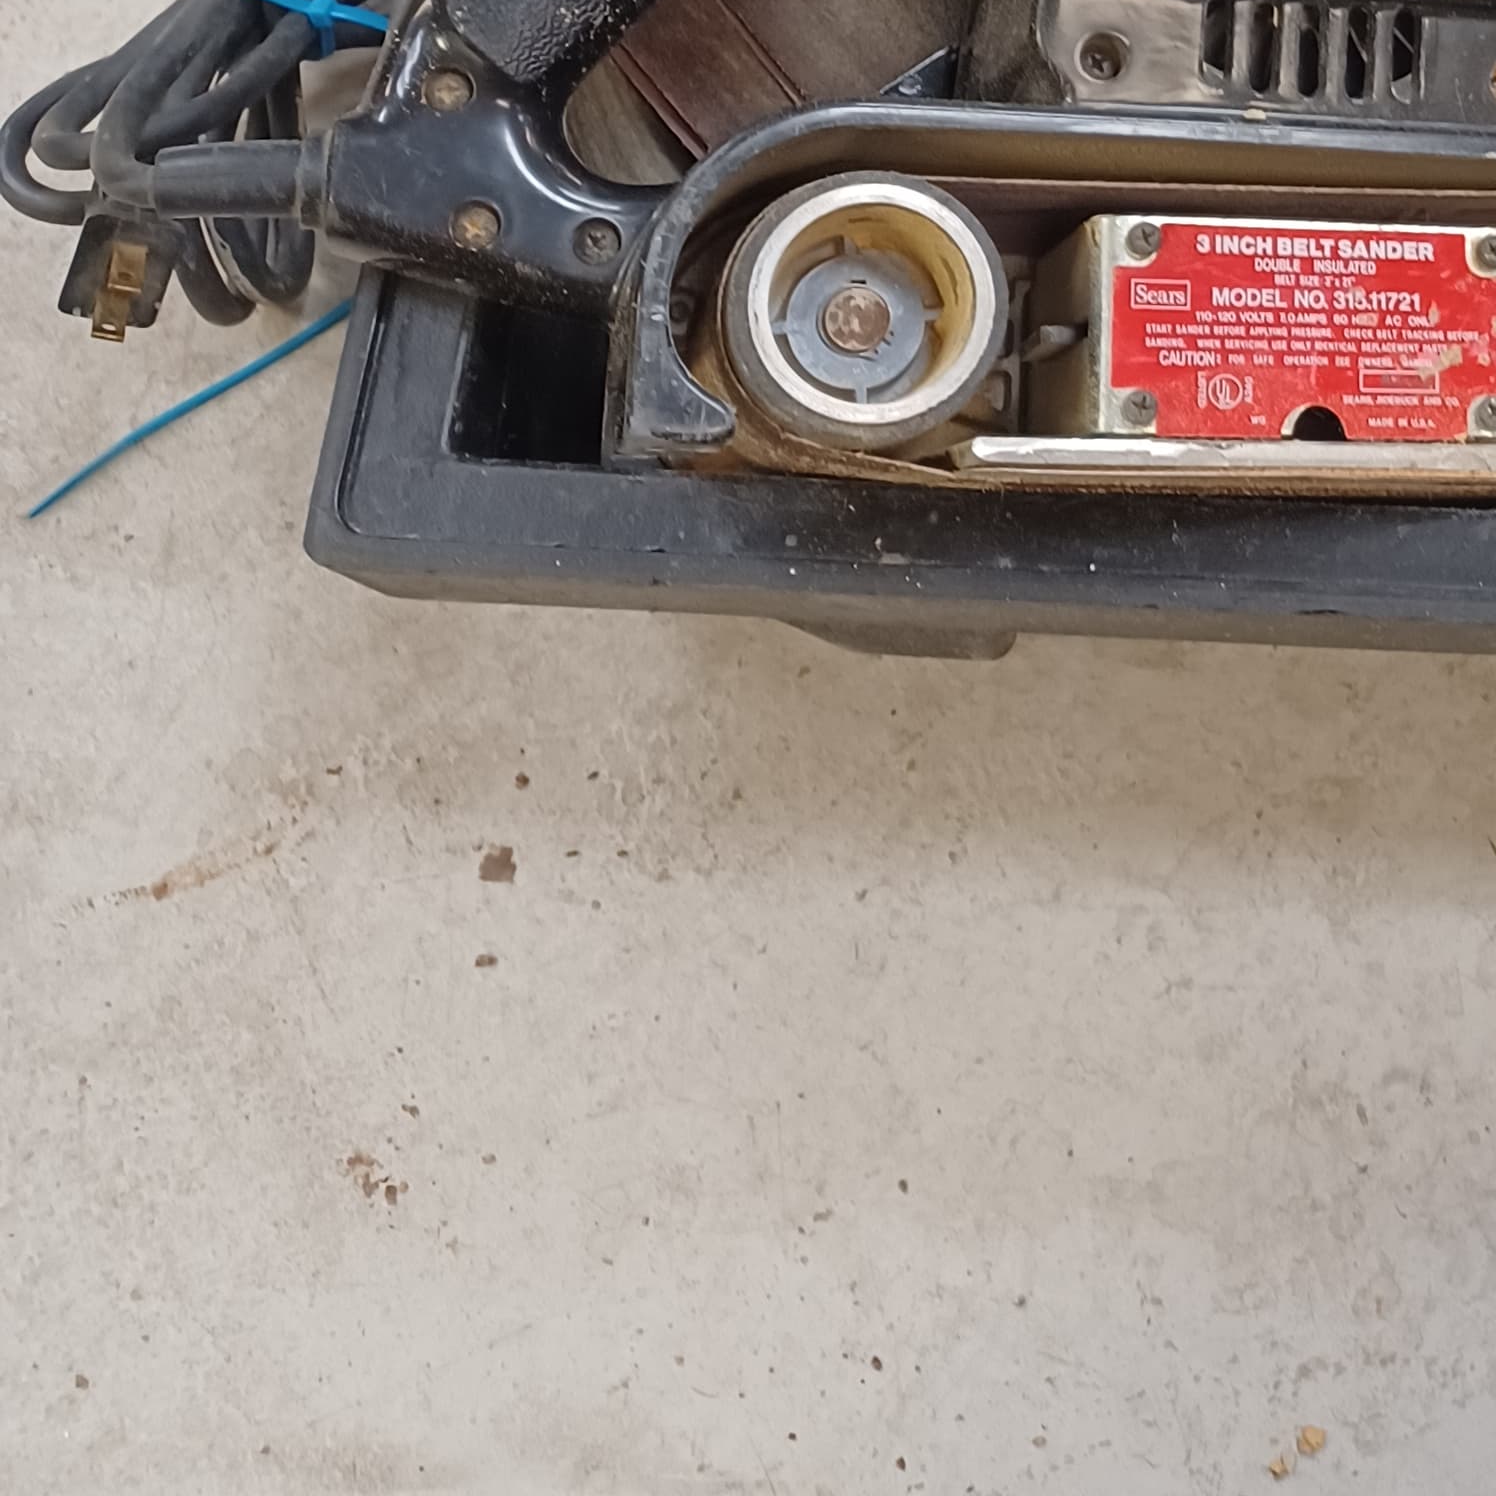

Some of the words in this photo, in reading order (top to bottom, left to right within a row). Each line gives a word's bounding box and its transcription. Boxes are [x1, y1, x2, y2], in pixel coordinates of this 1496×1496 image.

[1196, 234, 1211, 253] 3
[1215, 234, 1273, 255] INCH
[1276, 237, 1335, 258] BELT
[1337, 239, 1435, 261] SANDER
[1254, 257, 1300, 273] DOUBLE
[1313, 259, 1377, 275] INSULATED
[1274, 274, 1296, 286] BELT
[1135, 284, 1186, 305] Sears
[1211, 287, 1288, 308] MODEL
[1294, 289, 1328, 310] NO.
[1333, 290, 1421, 312] 315.11721
[1195, 311, 1237, 323] 110-120
[1239, 312, 1274, 323] VOLTS
[1385, 314, 1402, 327] AC
[1407, 315, 1436, 327] ONL
[1145, 324, 1172, 335] START
[1175, 324, 1211, 336] SANDER
[1213, 325, 1246, 337] BEFORE
[1344, 327, 1374, 340] CHECK
[1376, 328, 1398, 340] BELT
[1228, 354, 1245, 365] FOR
